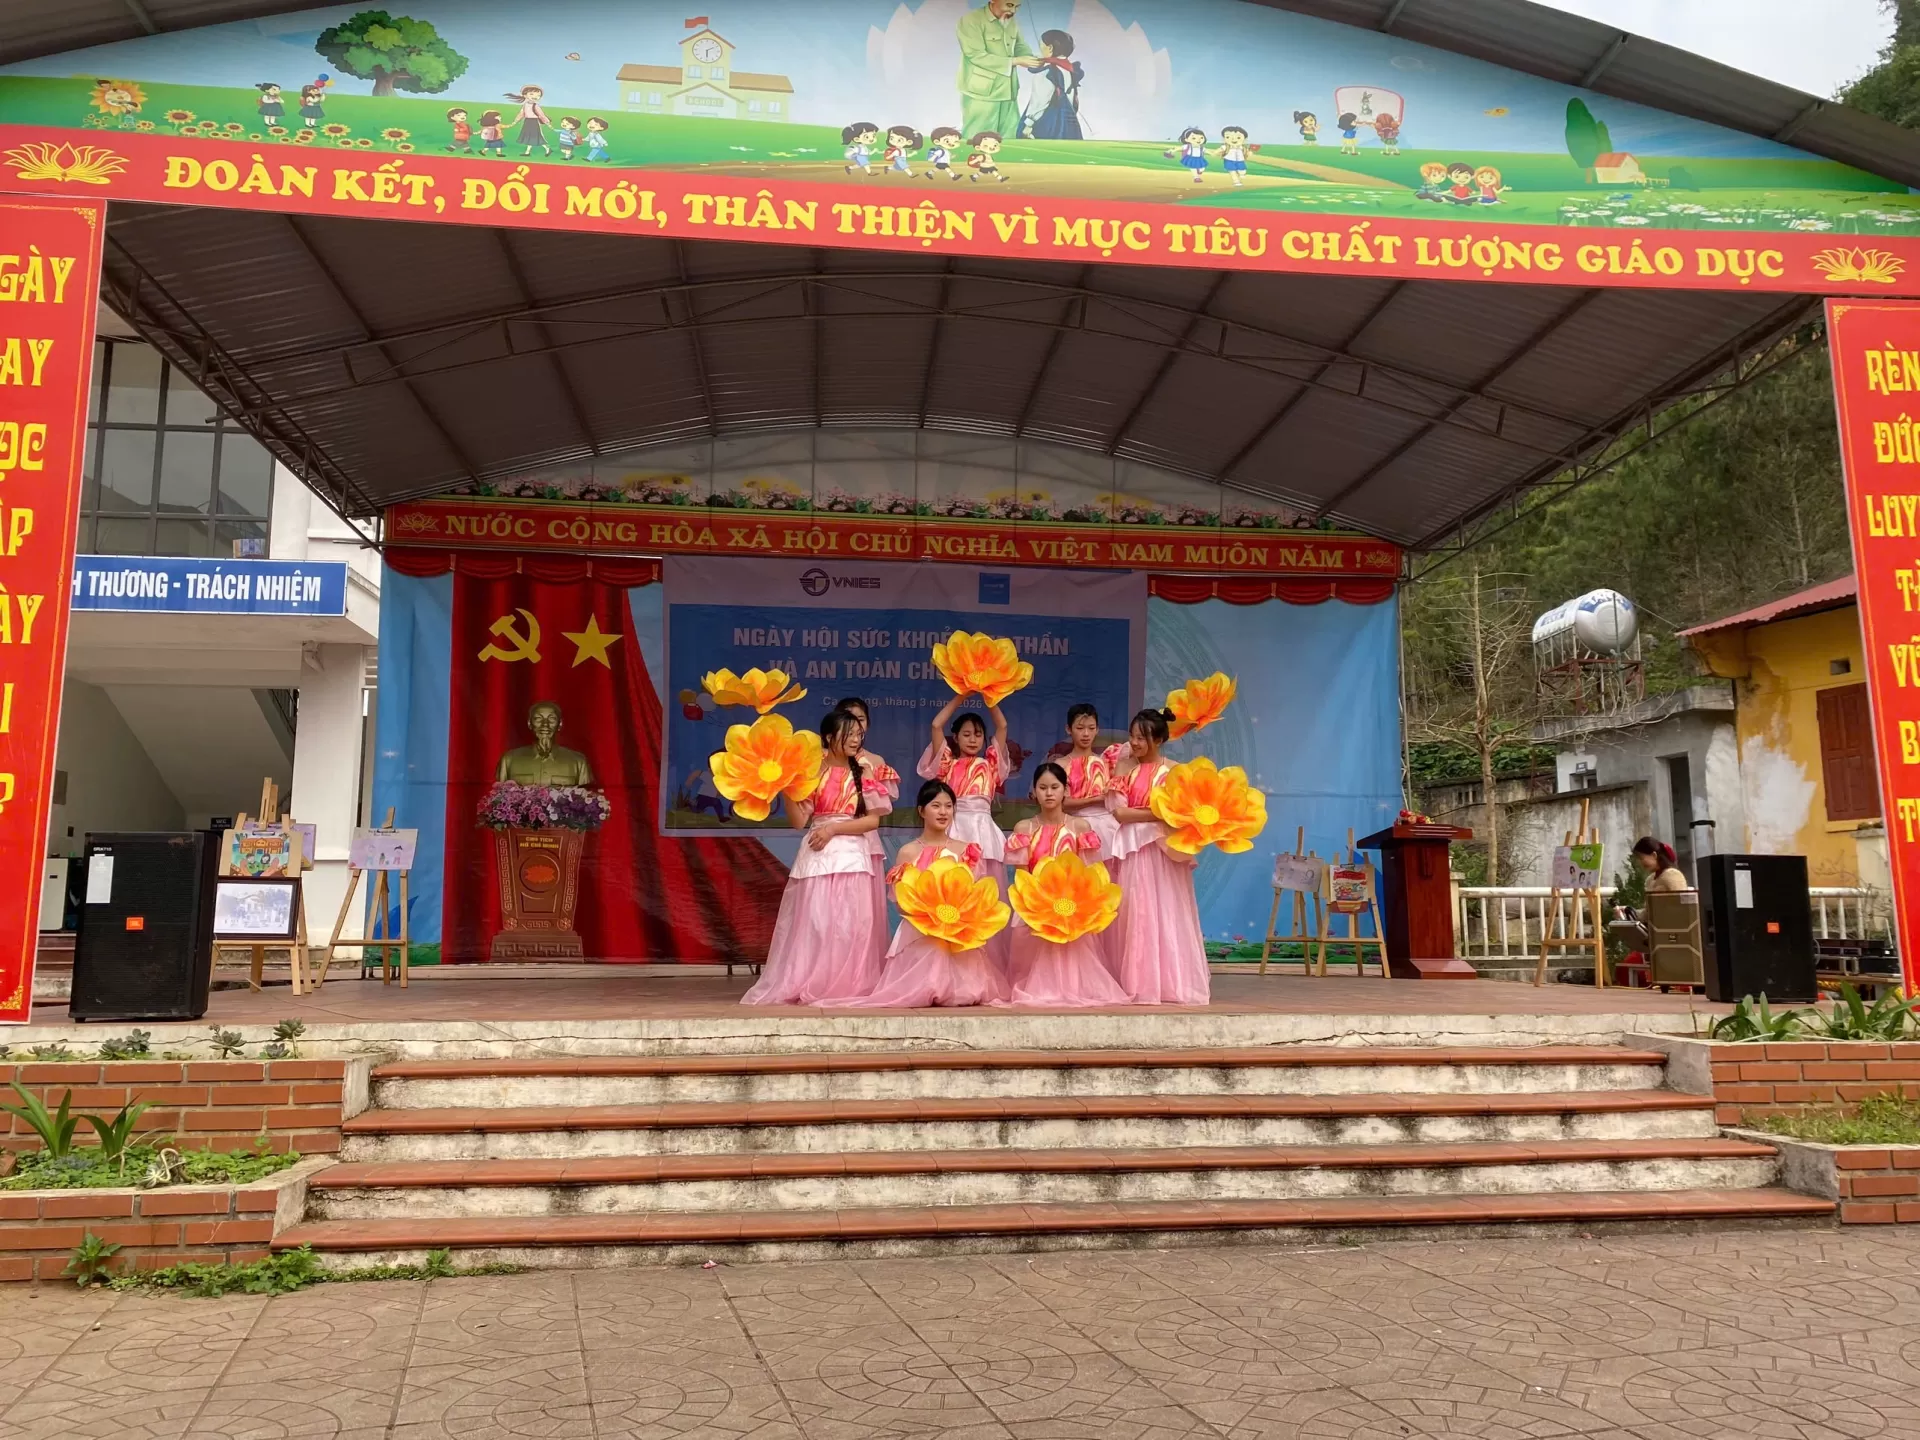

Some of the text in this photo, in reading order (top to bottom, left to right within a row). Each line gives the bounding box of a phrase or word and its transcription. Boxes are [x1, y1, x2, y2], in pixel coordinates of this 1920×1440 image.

[164, 153, 1784, 285] ĐOÀN KẾT, ĐỔI MỚI, THÂN THIỆN VÌ MỤC TIÊU CHẤT LƯỢNG GIÁO DỤC
[445, 512, 536, 539] NƯỚC
[548, 513, 638, 544] CỘNG
[650, 518, 719, 545] HÒA
[727, 522, 773, 548] XÃ
[783, 526, 839, 553] HỘI
[849, 526, 912, 554] CHỦ
[925, 533, 1019, 558] NGHĨA
[1029, 535, 1100, 564] VIỆT
[1109, 541, 1174, 564] NAM
[1185, 541, 1268, 568] MUÔN
[1279, 544, 1345, 569] NĂM
[88, 568, 169, 599] THƯƠNG
[186, 567, 250, 600] TRÁCH
[256, 569, 321, 607] NHIỆM
[832, 576, 881, 590] VNIES
[733, 624, 795, 647] NGÀY
[802, 626, 840, 652] HỘI
[847, 626, 891, 649] SỨC
[805, 660, 837, 680] AN
[844, 657, 901, 681] TOÀN
[823, 695, 839, 706] Ca
[886, 695, 916, 709] tháng
[920, 697, 927, 707] 3
